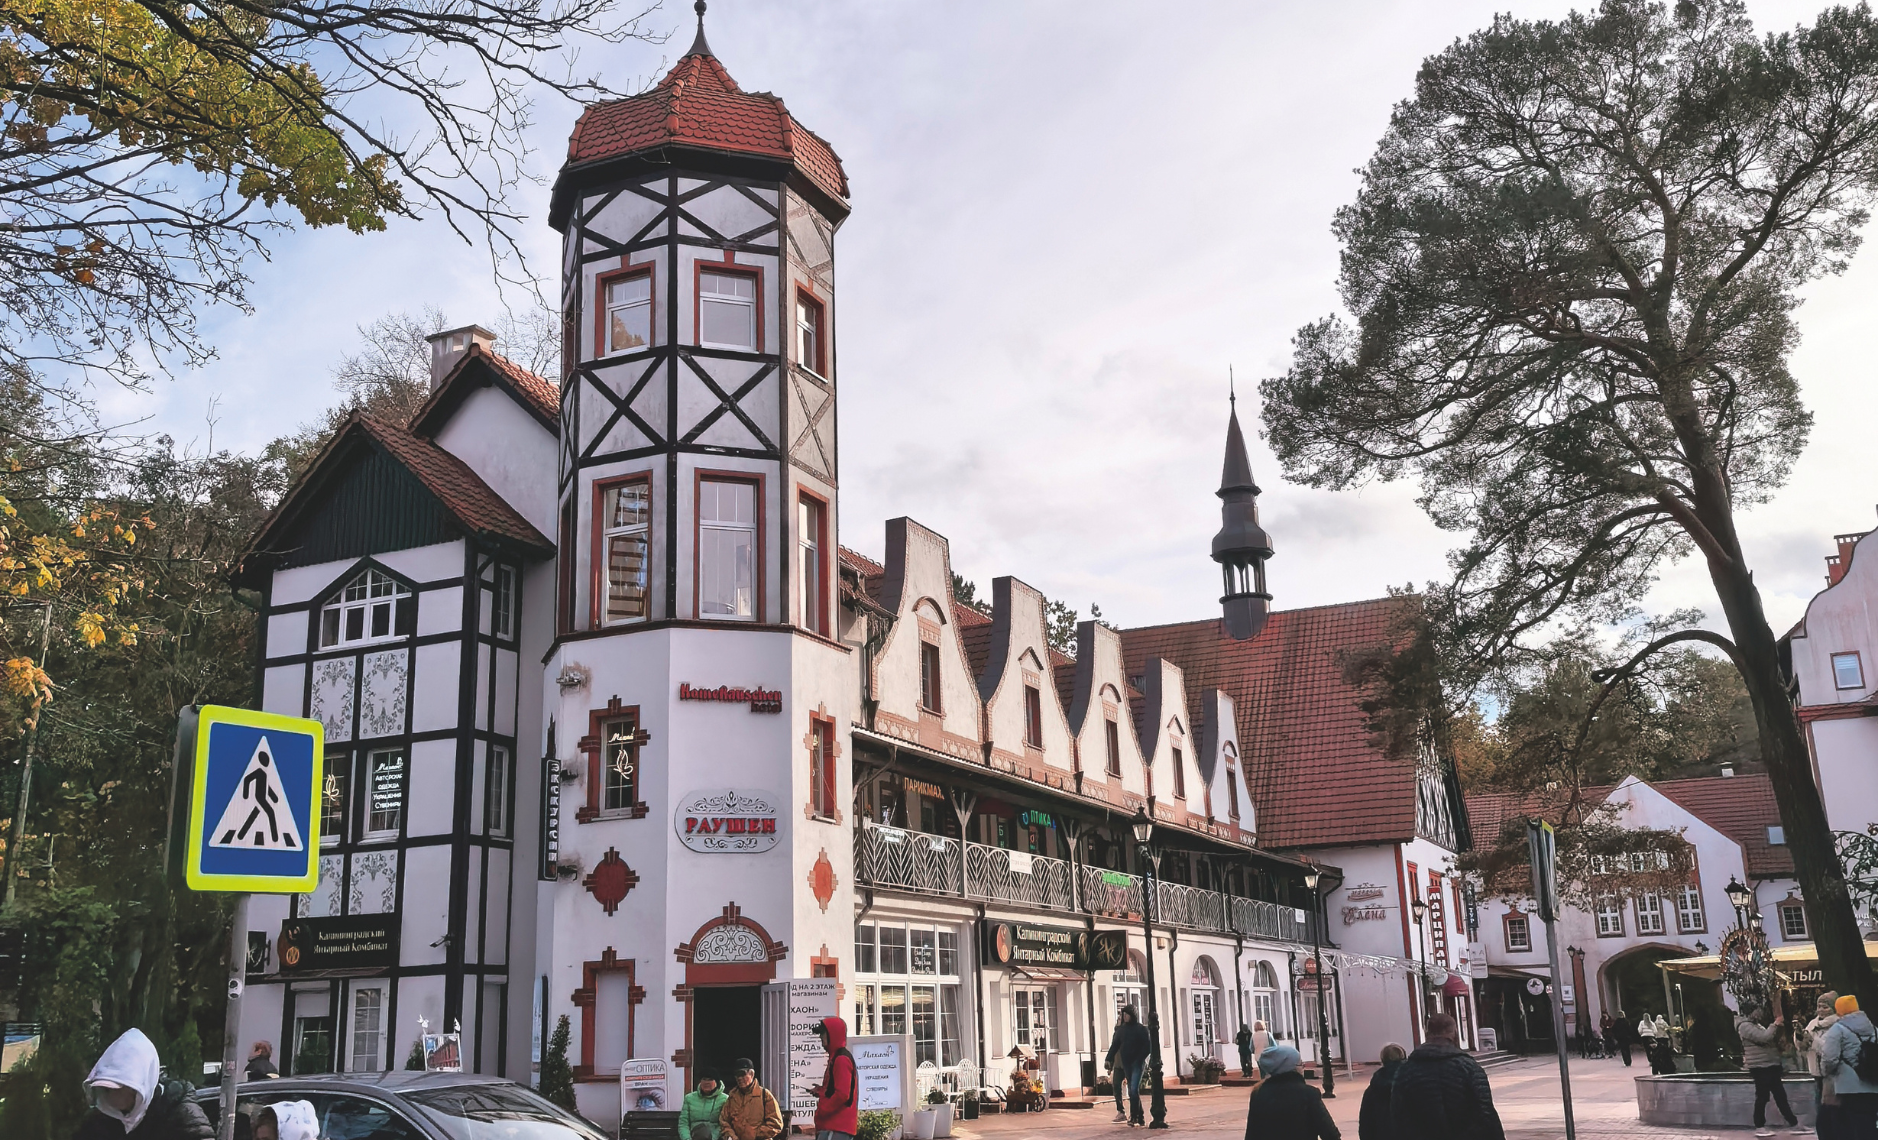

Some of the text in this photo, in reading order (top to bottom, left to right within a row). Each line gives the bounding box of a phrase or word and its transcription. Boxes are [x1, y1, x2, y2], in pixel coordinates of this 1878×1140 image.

[904, 777, 945, 801] ПАРИКМАХ
[548, 763, 560, 862] ЭКСКУРСИИ
[685, 817, 777, 834] РАУШЕН
[1016, 925, 1072, 946] Калининградский
[1429, 893, 1447, 967] МАРЦИПАН
[1012, 945, 1075, 964] Янтарный Комбинат
[636, 1064, 665, 1073] ОПТИКА
